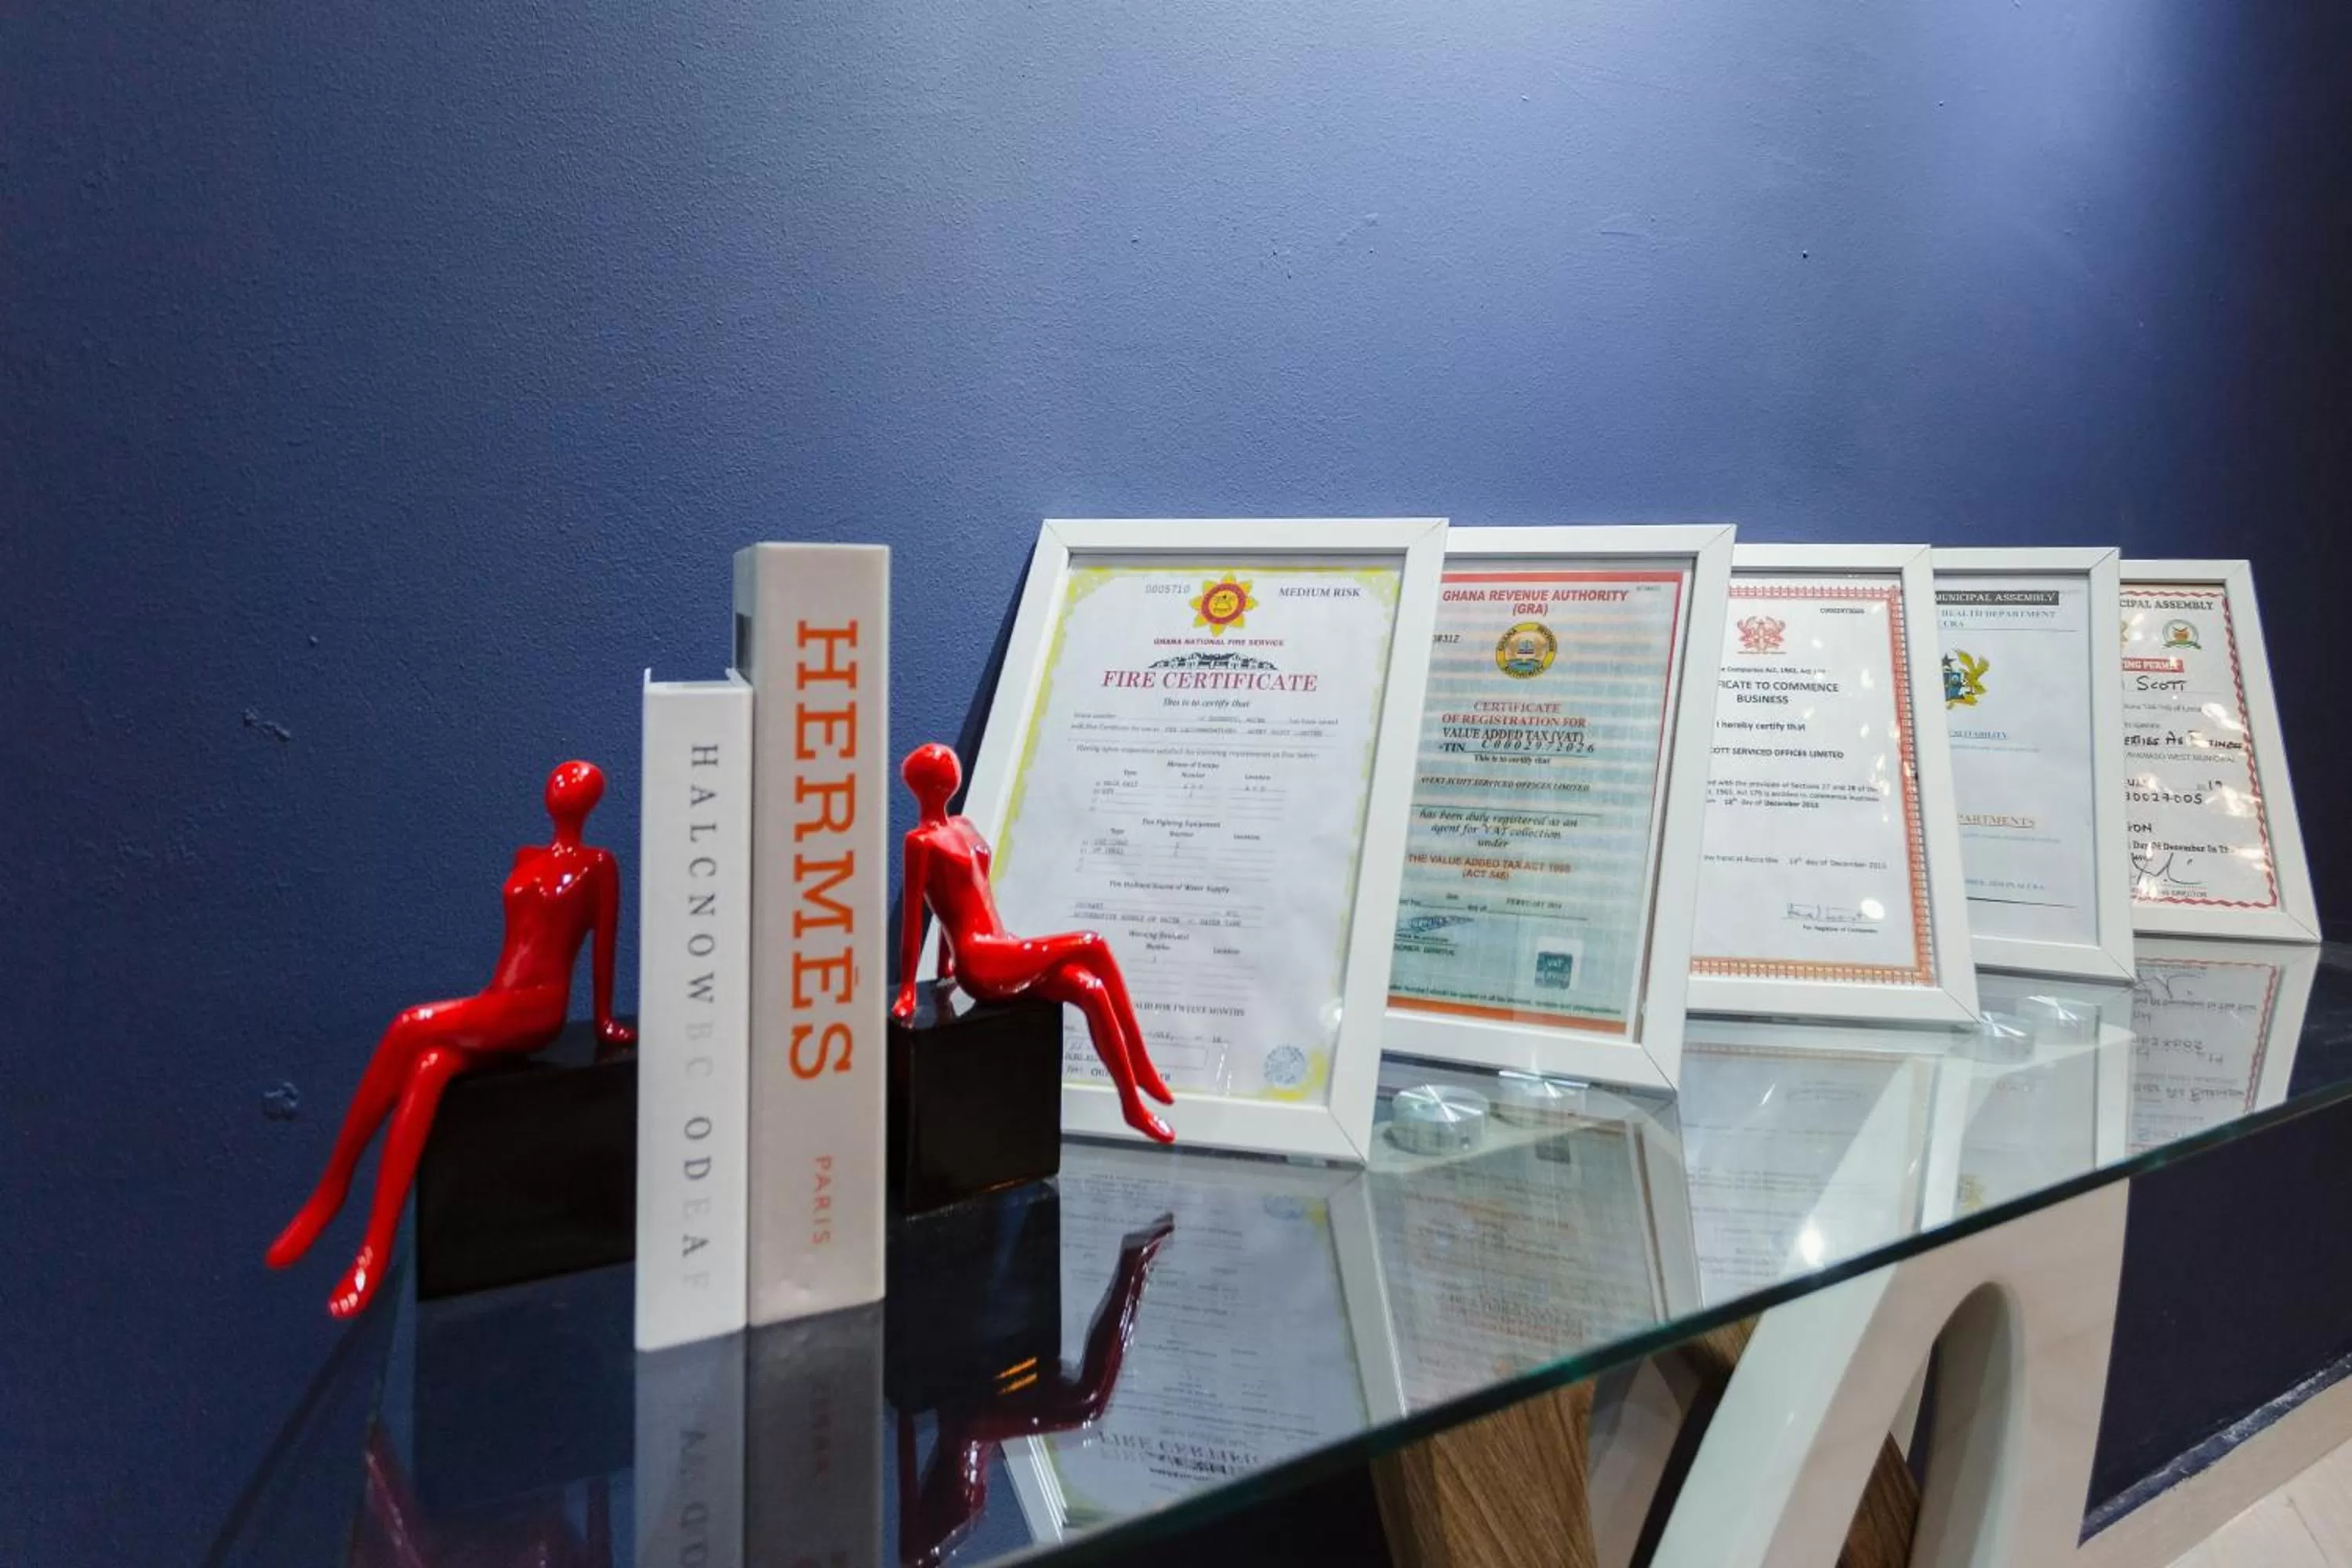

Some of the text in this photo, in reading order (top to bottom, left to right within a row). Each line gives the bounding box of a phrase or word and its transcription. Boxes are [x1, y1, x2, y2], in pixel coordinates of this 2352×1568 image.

[1279, 587, 1362, 597] MEDIUM RISK
[1442, 590, 1486, 602] GHANA
[1489, 590, 1549, 601] REVENUE
[1552, 589, 1629, 601] AUTHORITY
[1934, 593, 2056, 602] MUNICIPAL ASSEMBLY
[1512, 603, 1548, 616] (GRA)
[2155, 600, 2214, 610] ASSEMBLY
[1184, 638, 1225, 647] NATIONAL
[1248, 639, 1285, 648] SERVICE
[1102, 670, 1319, 693] FIRE CERTIFICATE
[1755, 681, 1771, 690] TO
[1772, 681, 1839, 692] COMMENCE
[1737, 694, 1789, 705] BUSINESS
[1473, 701, 1562, 713] CERTIFICATE
[1442, 713, 1587, 728] OF REGISTRATION FOR
[1721, 721, 1754, 731] hereby
[1755, 722, 1784, 731] certify
[1443, 726, 1585, 744] VALUE ADDED TAX (VAT)
[1732, 747, 1773, 757] SERVICED
[1774, 748, 1807, 757] OFFICES
[1809, 750, 1845, 759] LIMITED
[1419, 808, 1437, 818] has
[1439, 810, 1463, 821] been
[1492, 814, 1546, 826] registered
[1431, 824, 1461, 836] agent
[1462, 824, 1478, 837] for
[1509, 827, 1561, 840] collection
[1478, 837, 1509, 848] under
[1430, 854, 1461, 866] VALUE
[1464, 856, 1501, 868] ADDED
[811, 1153, 833, 1246] PARIS
